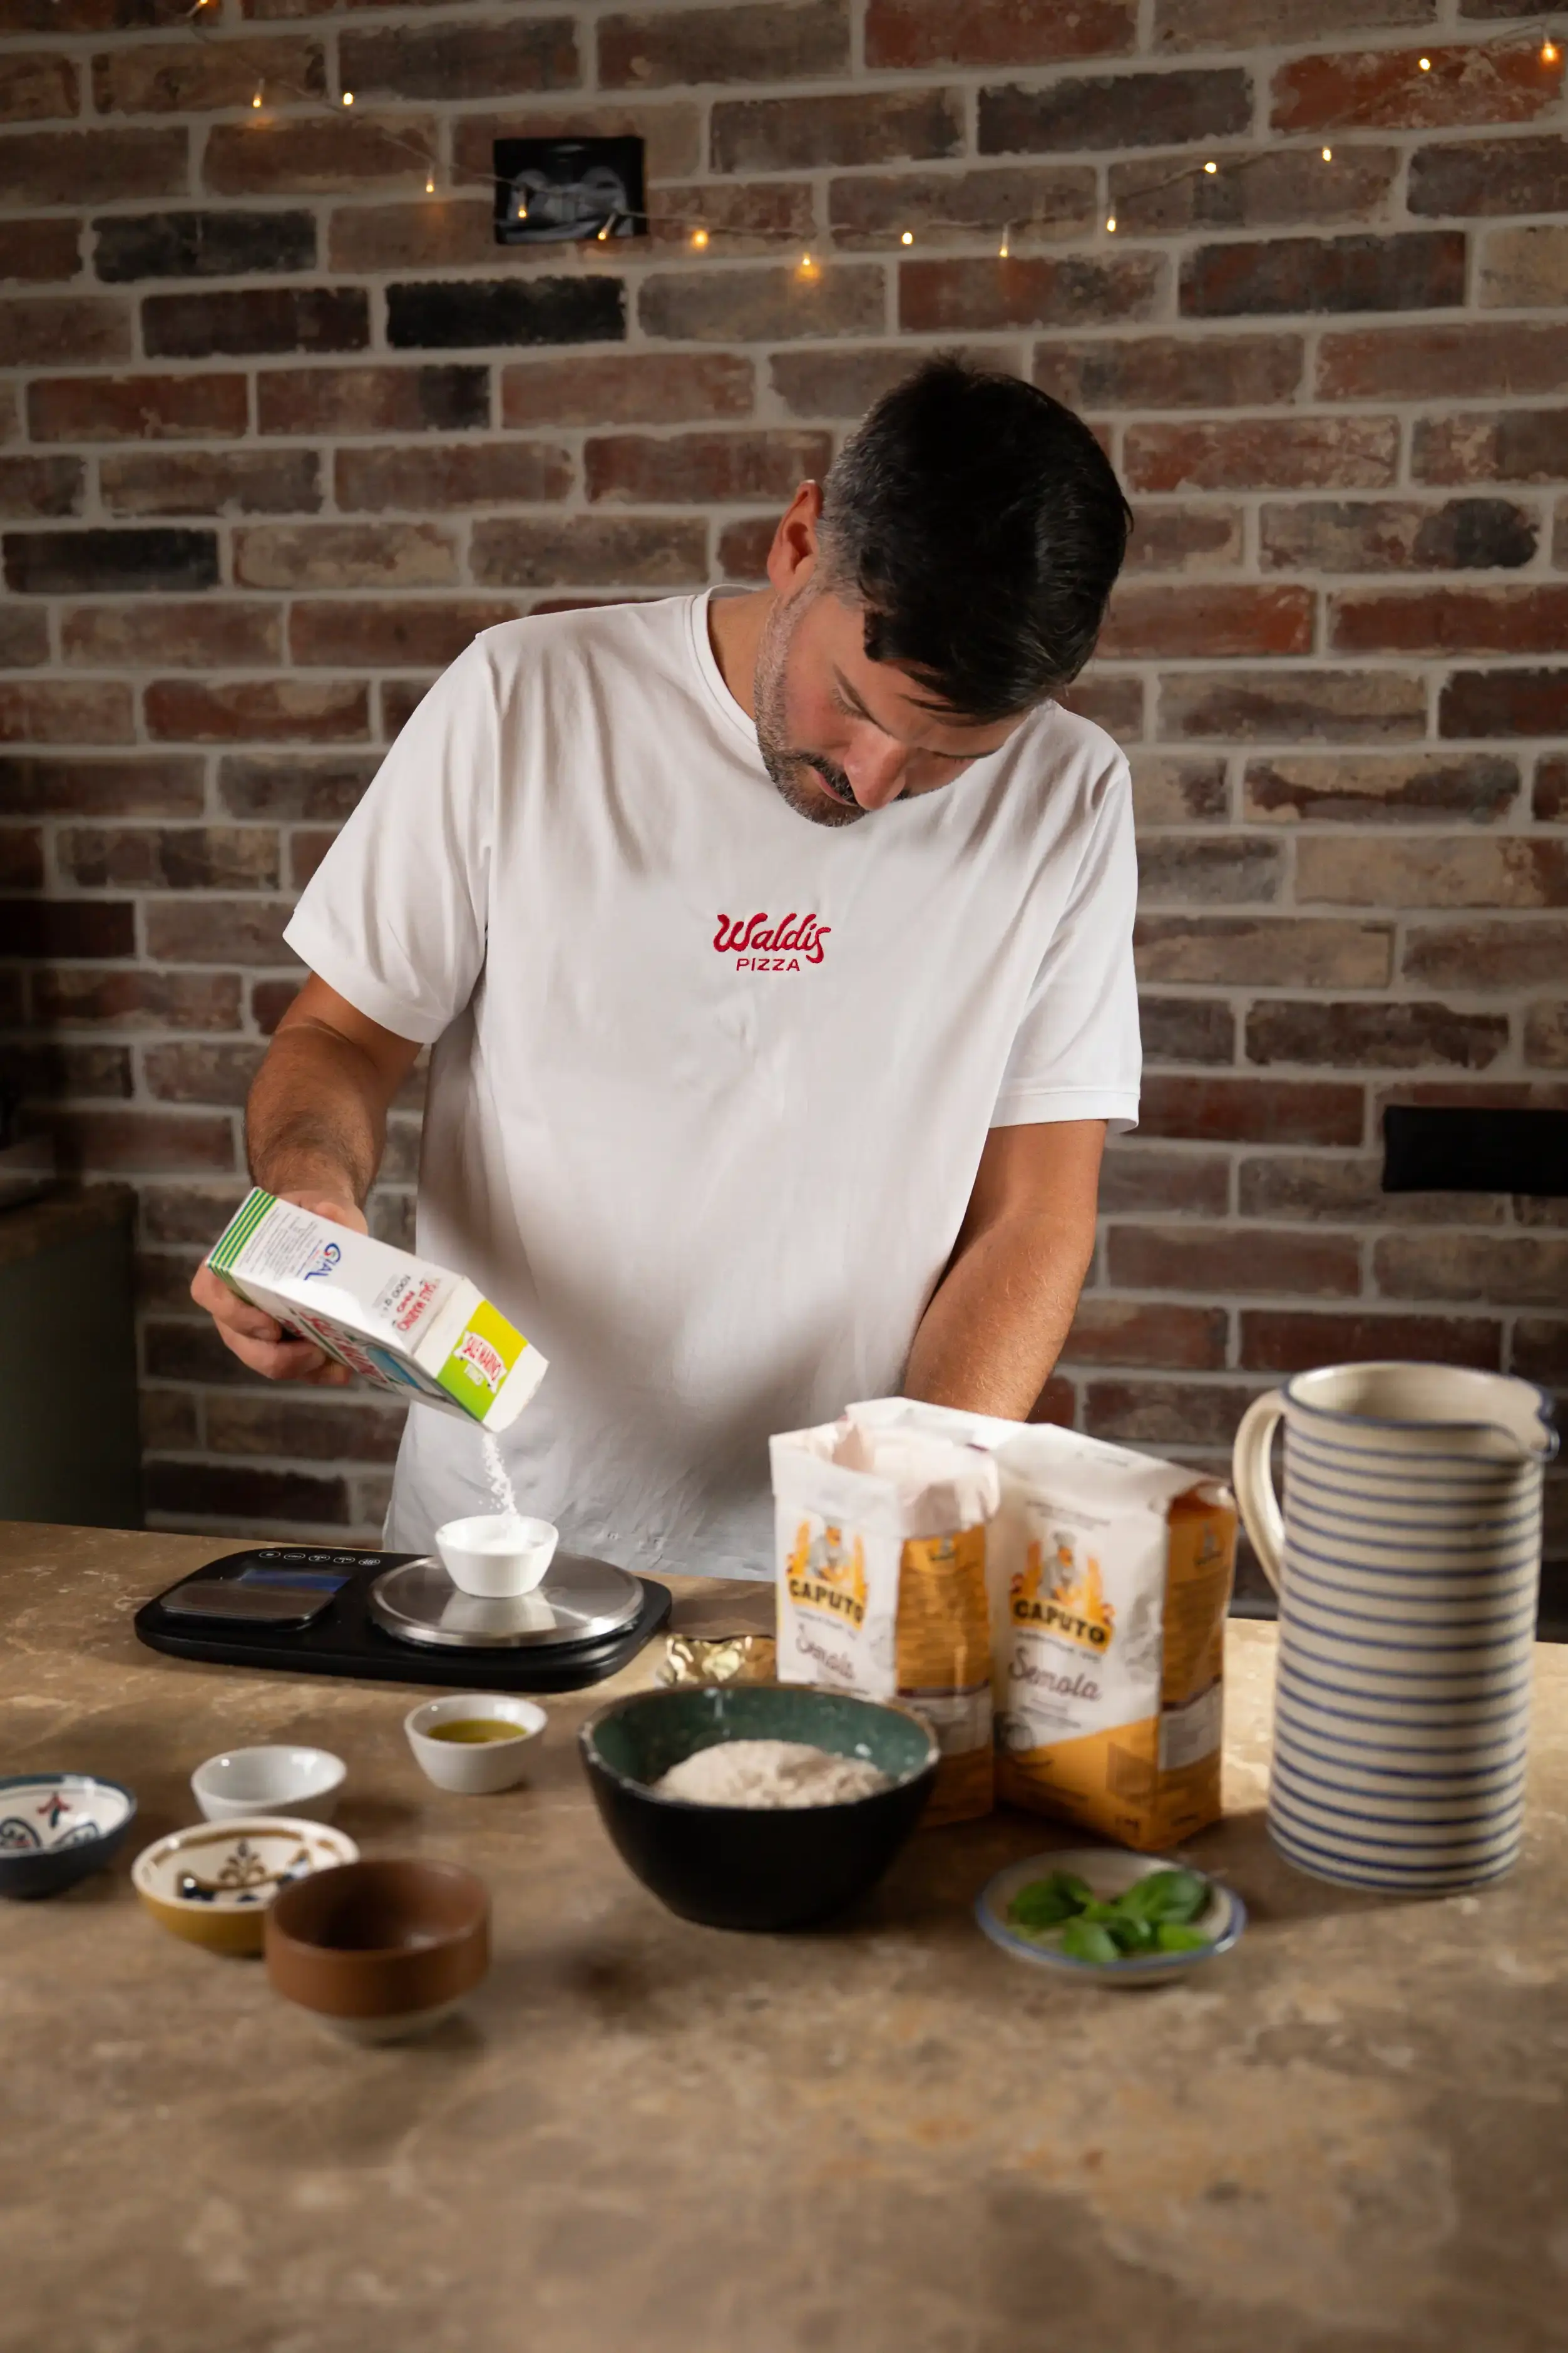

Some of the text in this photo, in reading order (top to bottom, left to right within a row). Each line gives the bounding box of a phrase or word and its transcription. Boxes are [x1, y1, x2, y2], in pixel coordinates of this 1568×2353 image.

[713, 912, 831, 964] Waldis
[736, 957, 801, 972] PIZZA
[789, 1579, 864, 1625] CAPUTO
[1013, 1599, 1105, 1646] CAPUTO
[1007, 1647, 1102, 1701] Semola
